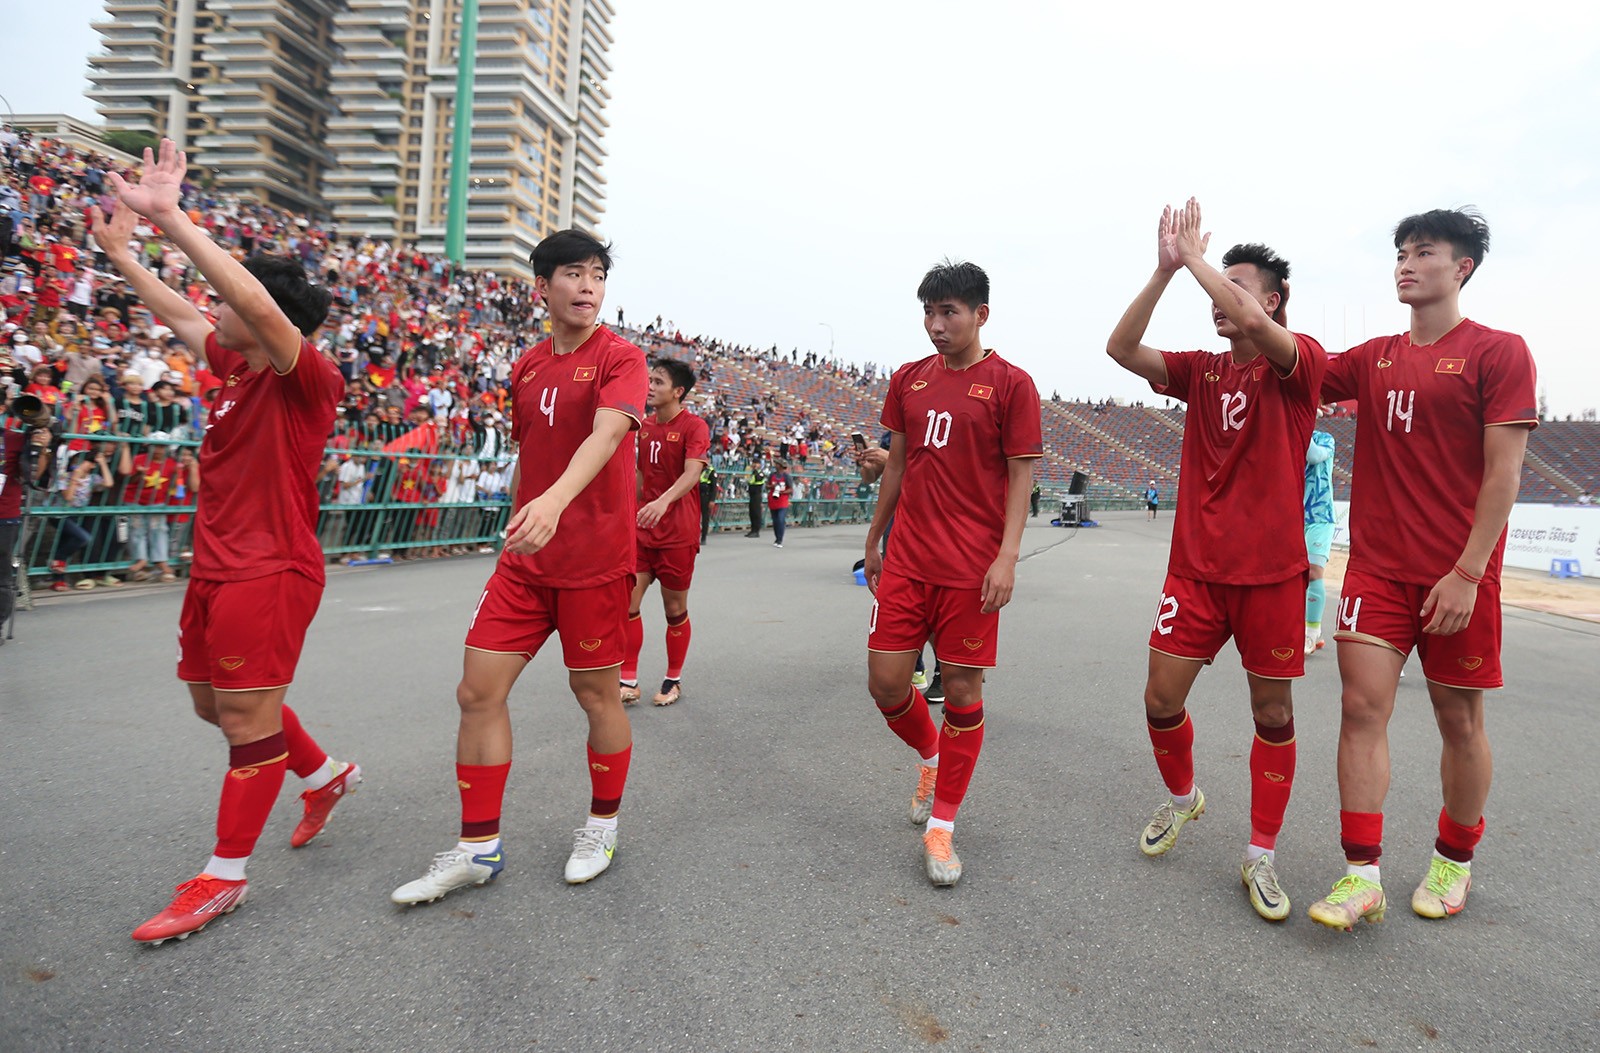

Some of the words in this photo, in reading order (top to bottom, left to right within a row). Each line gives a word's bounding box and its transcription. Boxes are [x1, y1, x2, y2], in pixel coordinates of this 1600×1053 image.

[539, 387, 558, 427] 4
[1220, 390, 1248, 432] 12
[1386, 389, 1416, 434] 14
[923, 409, 953, 449] 10
[1152, 592, 1180, 636] 12
